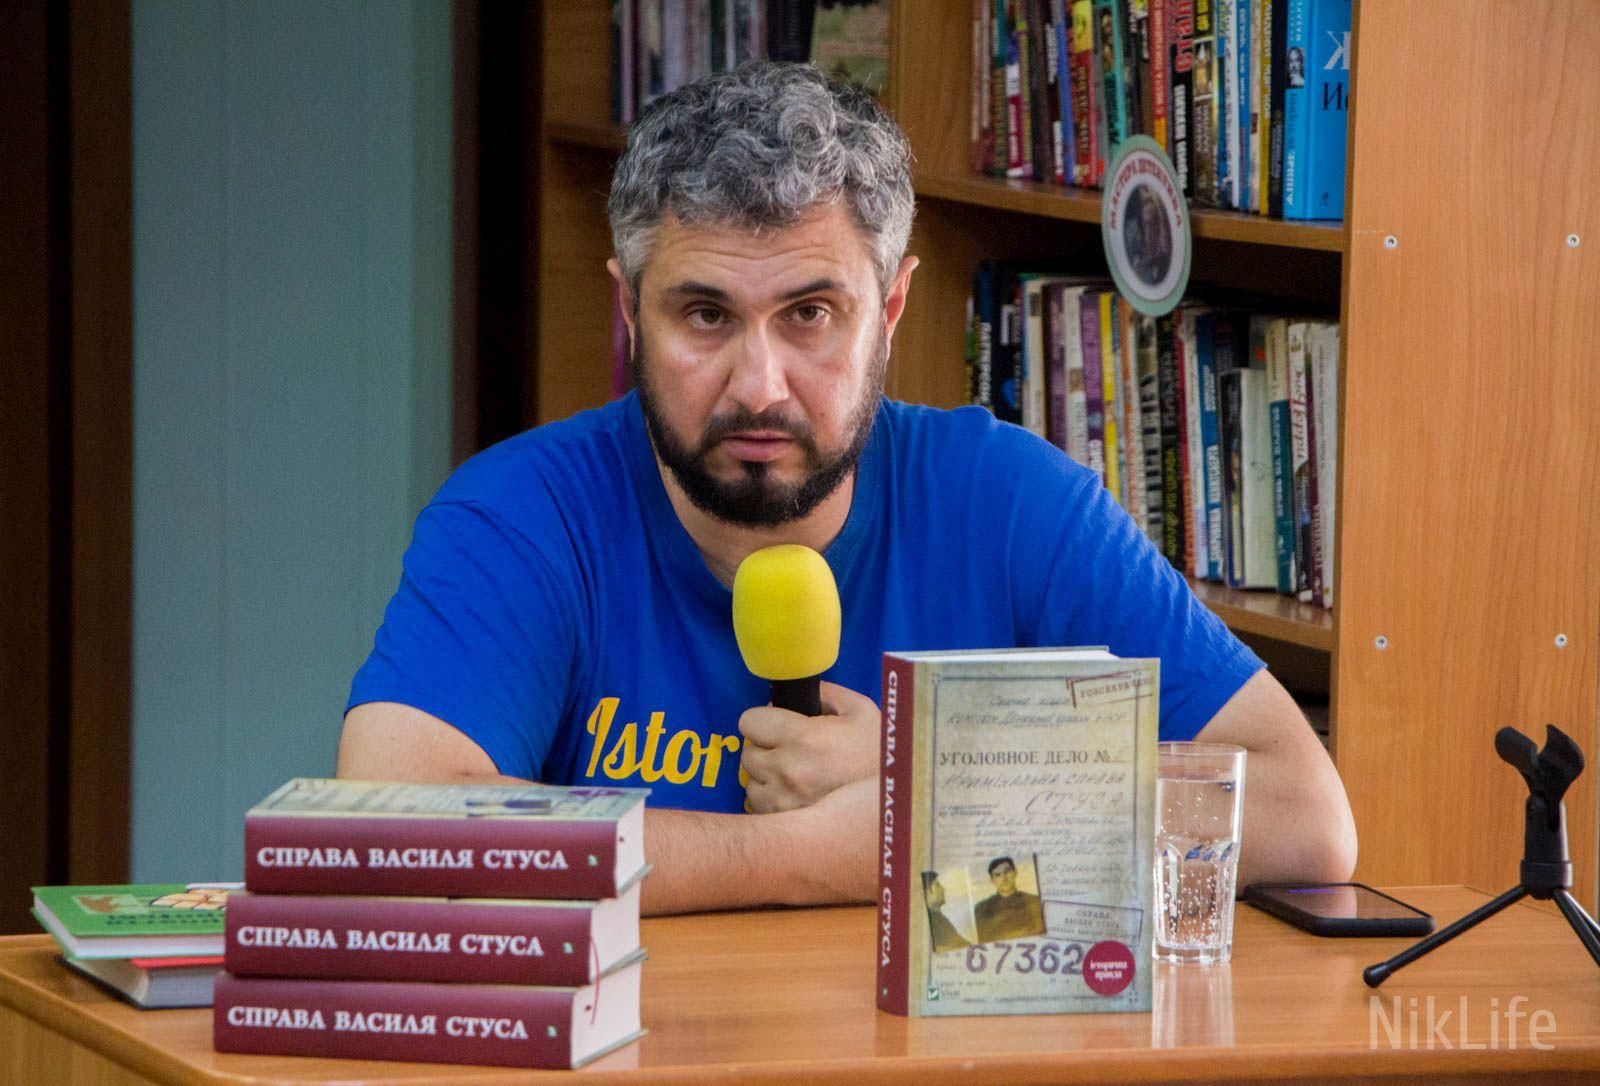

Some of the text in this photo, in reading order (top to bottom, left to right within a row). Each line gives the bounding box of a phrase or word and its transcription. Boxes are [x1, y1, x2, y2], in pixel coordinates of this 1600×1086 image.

[1110, 158, 1182, 230] МАСТЕРА ДЕТЕКТИВА
[585, 697, 752, 789] Istor
[940, 751, 1040, 766] УГОЛОВНОЕ
[1044, 750, 1088, 765] ДЕЛО
[881, 670, 898, 968] СПРАВА ВАСИЛЯ СТУСА
[257, 846, 569, 871] СПРАВА ВАСИЛЯ СТУСА
[237, 925, 544, 957] СПРАВА ВАСИЛЯ СТУСА
[966, 942, 1084, 975] 67362
[227, 1005, 528, 1040] СПРАВА ВАСИЛЯ СТУСА
